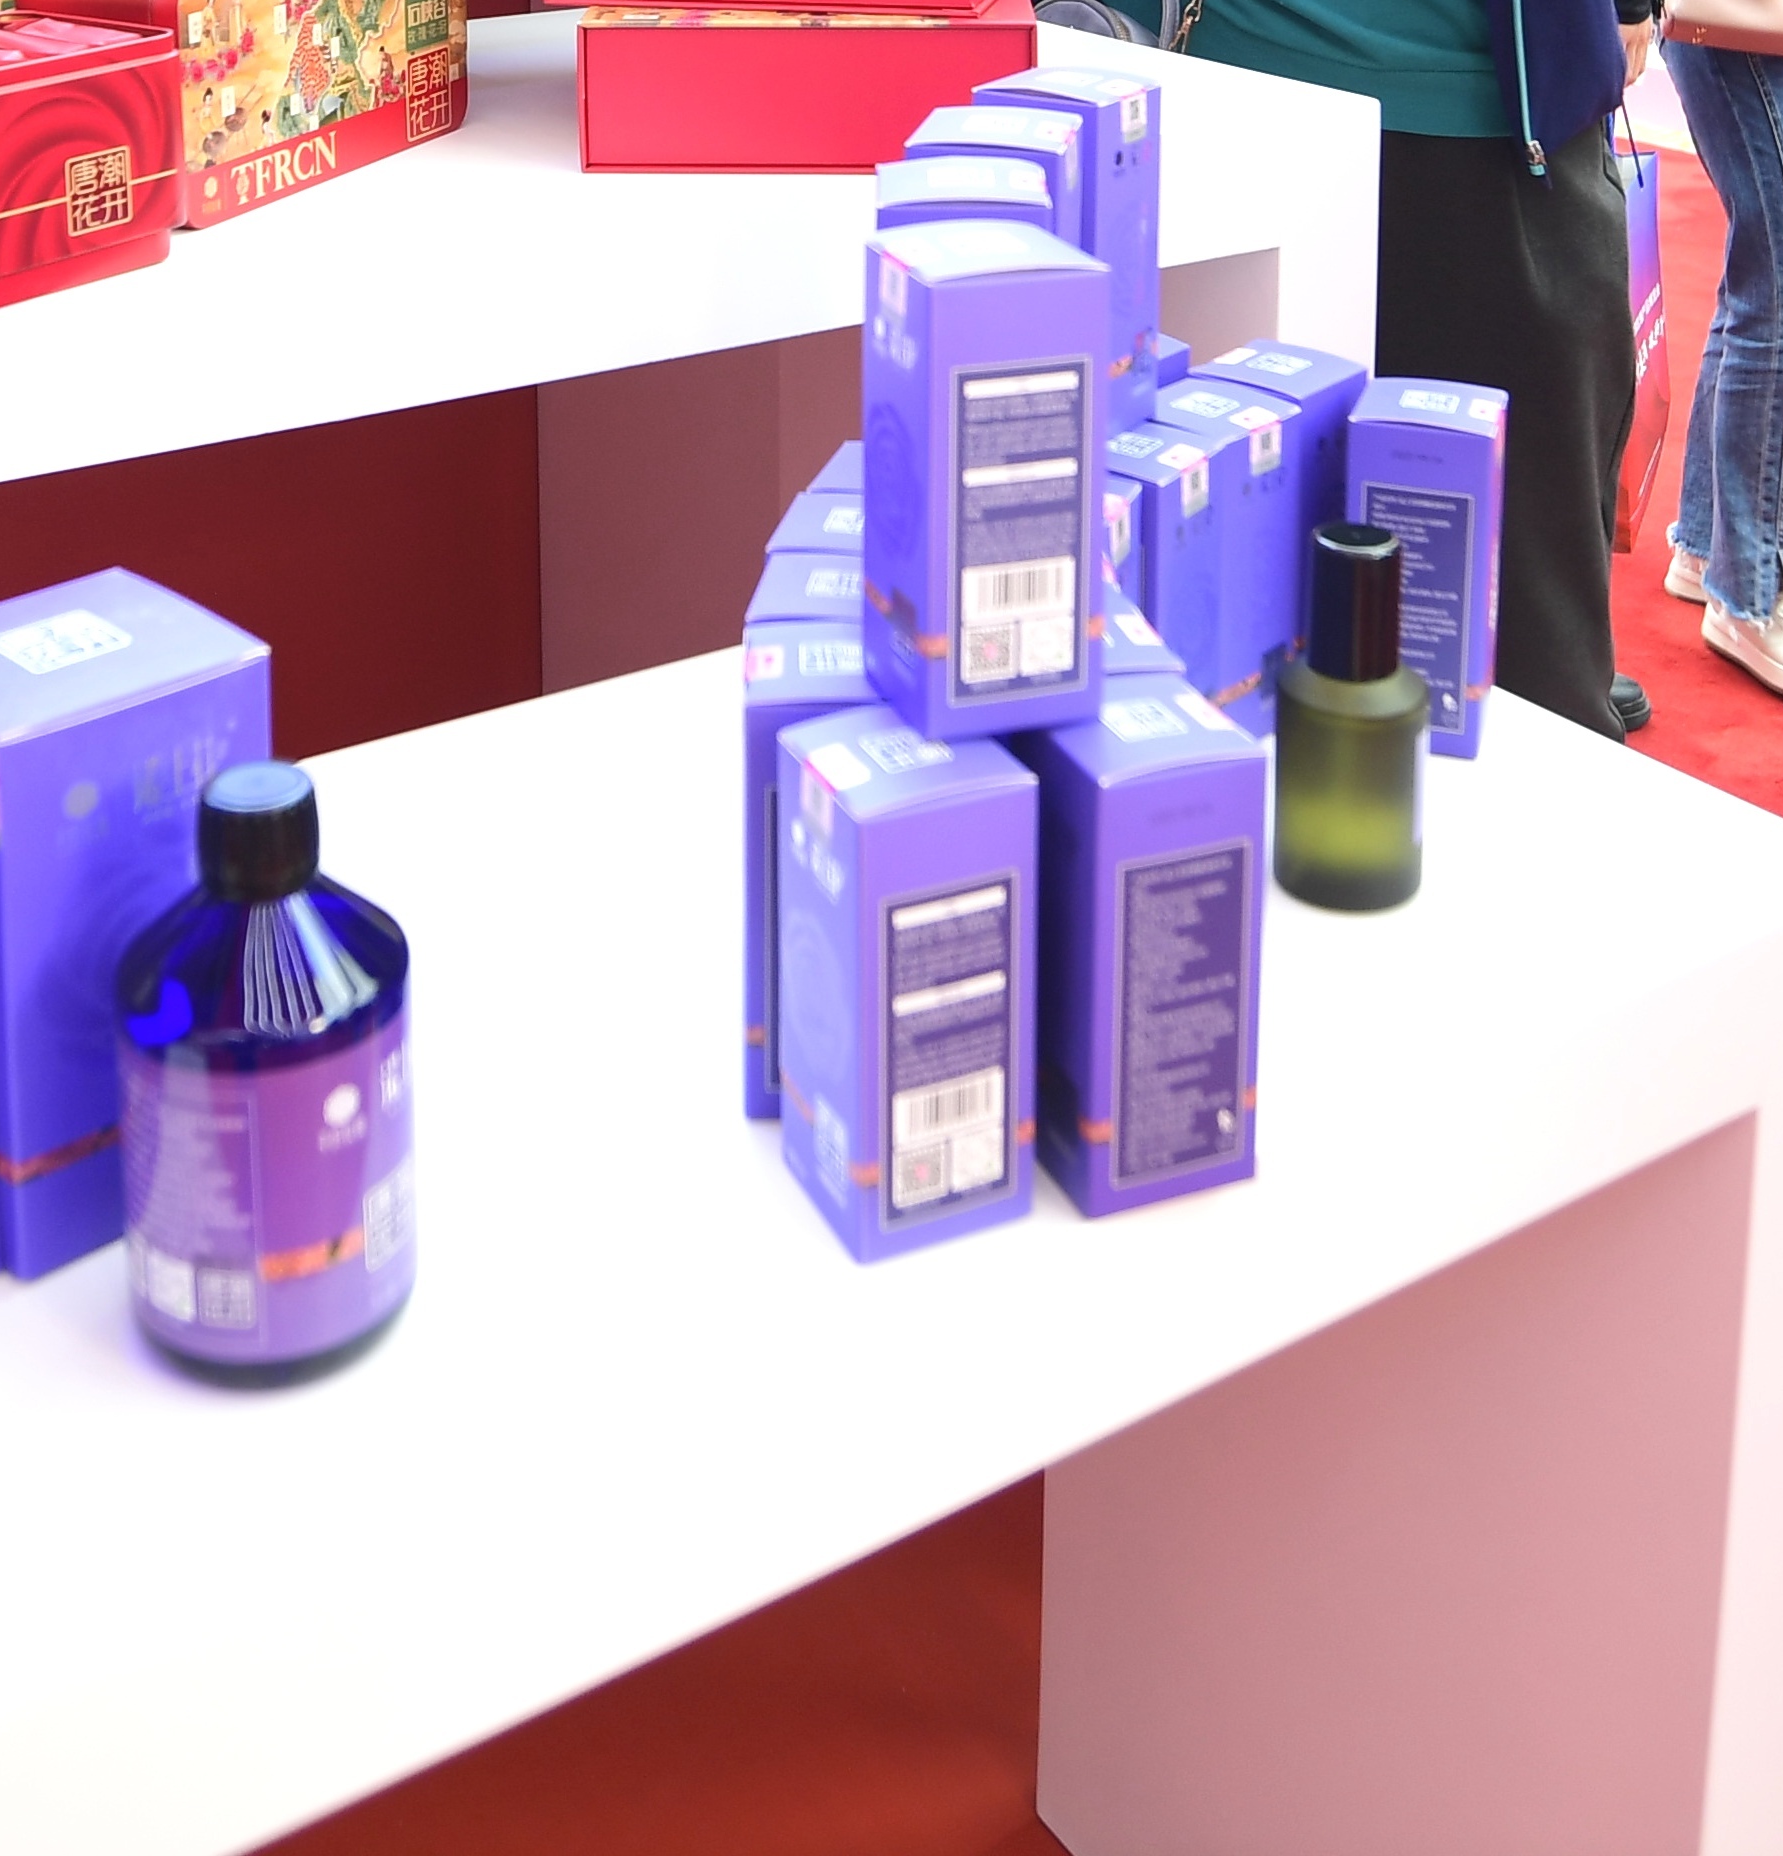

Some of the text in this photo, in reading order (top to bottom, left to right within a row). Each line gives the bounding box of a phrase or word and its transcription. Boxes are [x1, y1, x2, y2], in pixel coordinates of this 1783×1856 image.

[407, 50, 448, 96] 唐潮
[410, 89, 448, 136] 花开
[70, 152, 126, 196] 唐潮
[230, 130, 337, 206] TFRCN
[72, 186, 127, 230] 花开
